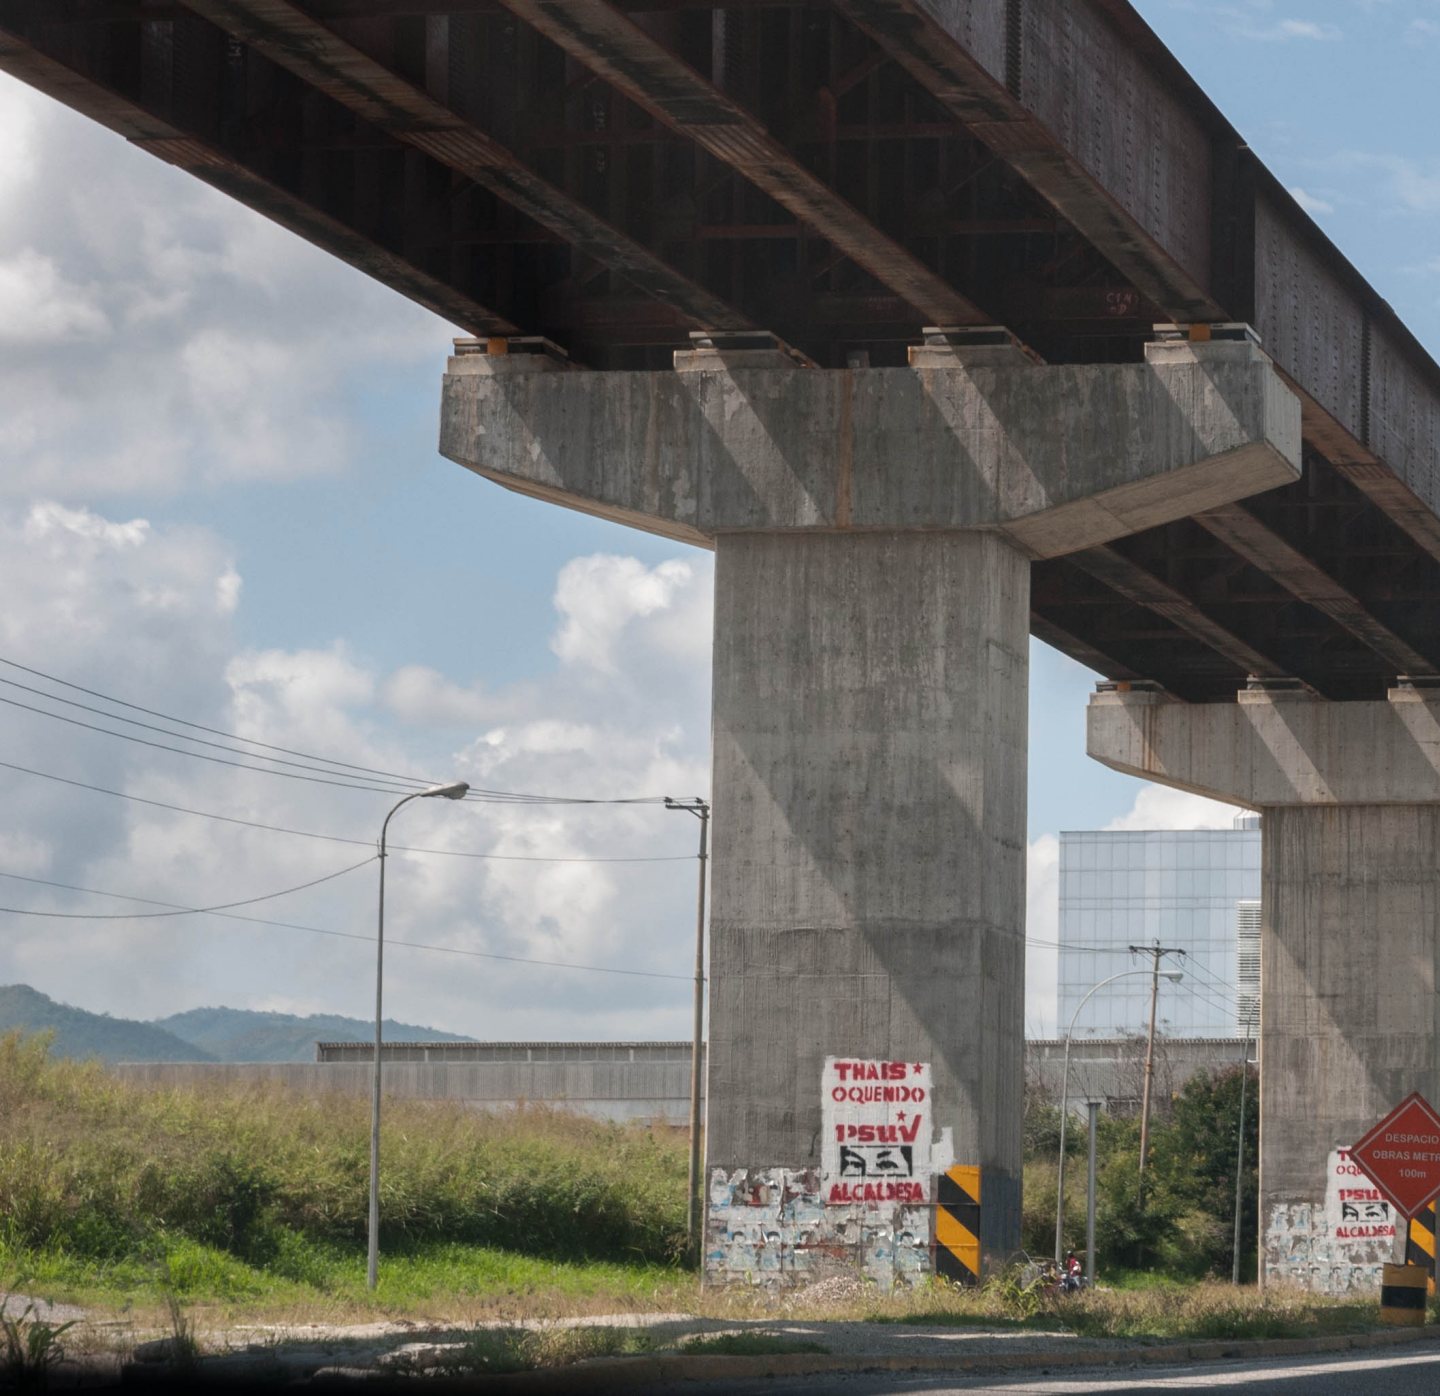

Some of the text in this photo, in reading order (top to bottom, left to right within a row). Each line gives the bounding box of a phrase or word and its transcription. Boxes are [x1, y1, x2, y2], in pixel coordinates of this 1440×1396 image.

[834, 1062, 907, 1081] THAIS
[832, 1086, 925, 1104] OQUENDO
[1385, 1133, 1440, 1145] DESPACIO
[1372, 1150, 1410, 1161] OBRAS
[1399, 1168, 1427, 1178] 100m
[829, 1182, 924, 1202] ALCALDESA
[1336, 1225, 1397, 1238] ALCALDESA
